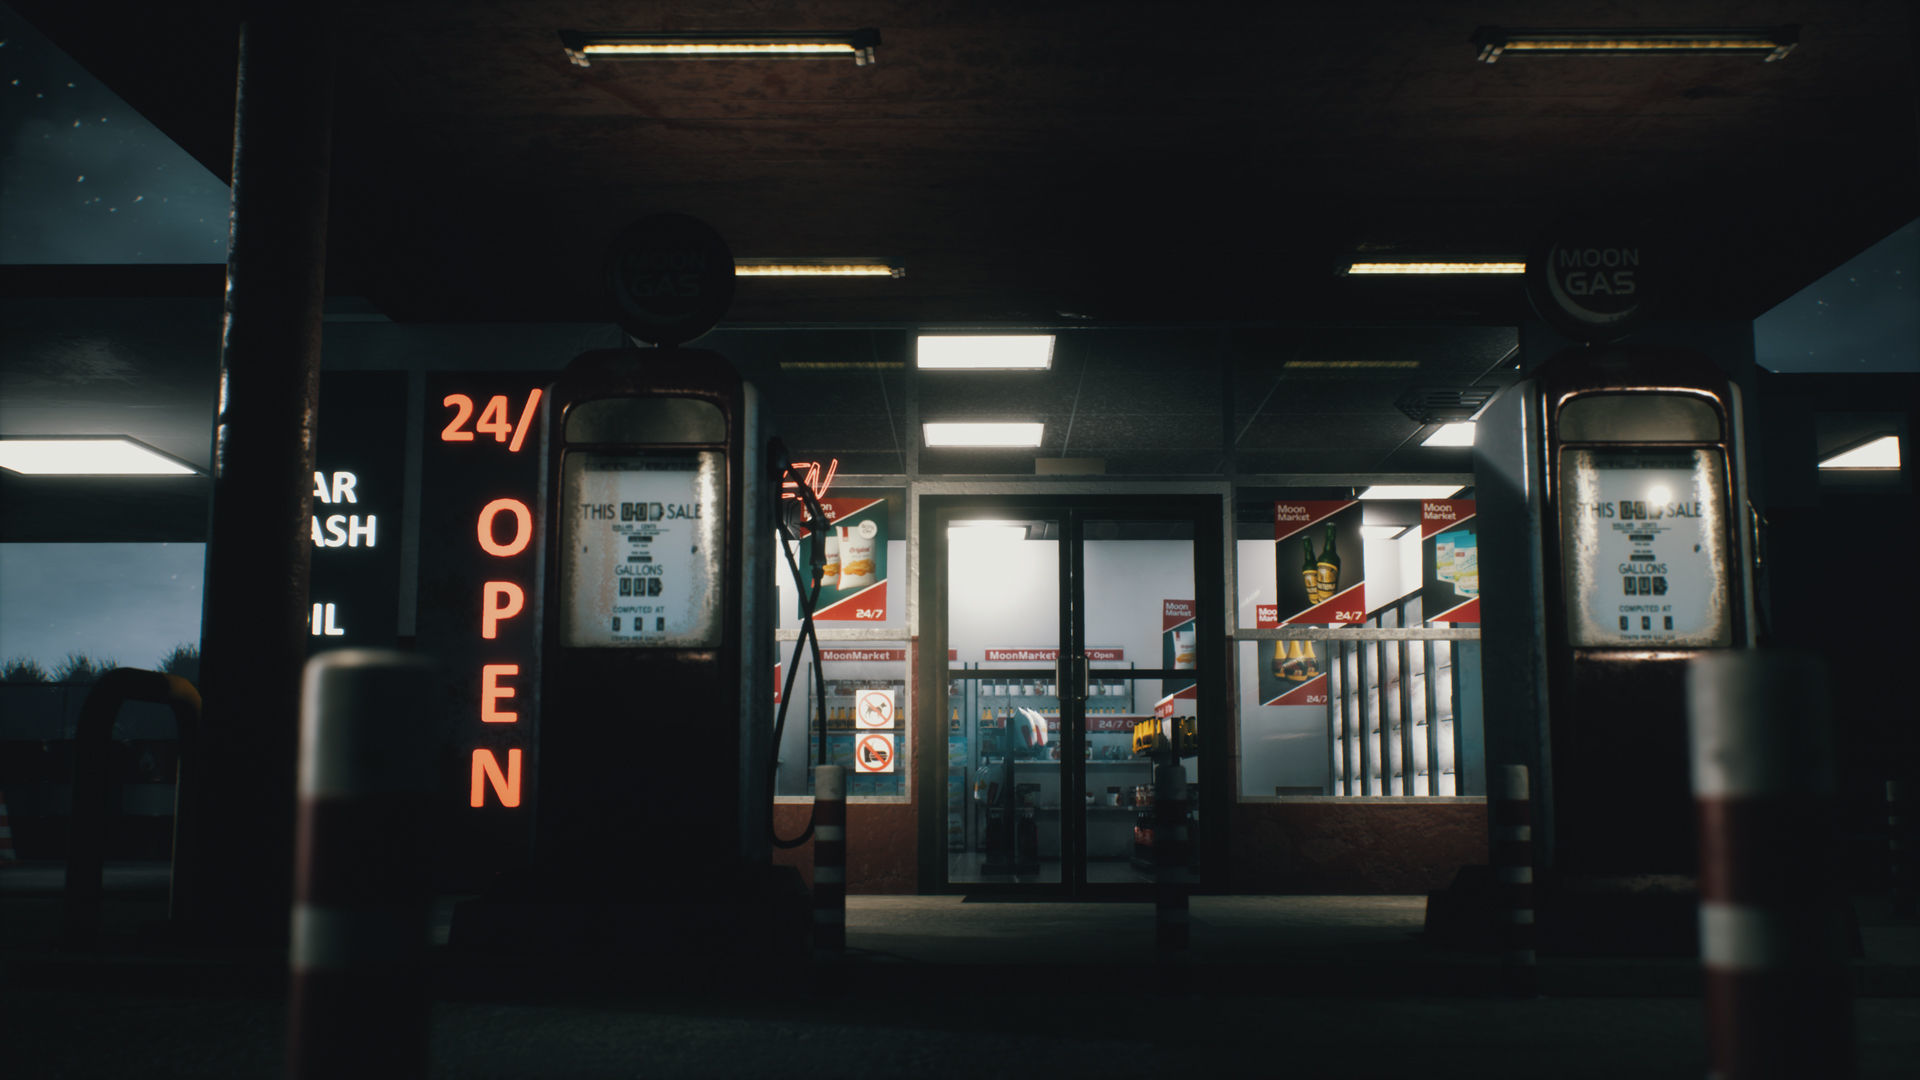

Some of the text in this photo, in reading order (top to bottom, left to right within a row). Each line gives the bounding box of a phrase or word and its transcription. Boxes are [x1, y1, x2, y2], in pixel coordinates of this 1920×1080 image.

[1560, 248, 1640, 268] MOON
[632, 273, 701, 297] GAS
[1565, 271, 1636, 296] GAS
[441, 388, 543, 452] 24/
[313, 471, 358, 503] AR
[581, 503, 616, 519] THIS
[666, 503, 703, 520] SALE
[1277, 504, 1306, 514] Moon
[1424, 503, 1452, 513] Moon
[1666, 502, 1703, 518] SALE
[1277, 513, 1310, 522] Market
[1424, 511, 1457, 521] Market
[311, 514, 377, 547] ASH
[615, 565, 663, 576] GALLONS
[1618, 563, 1668, 575] GALLONS
[612, 606, 665, 614] COMPUTED AT
[1166, 602, 1189, 610] Moon
[1619, 605, 1672, 613] COMPUTED AT
[856, 609, 884, 619] 24/7
[1166, 609, 1192, 617] Market
[1258, 607, 1277, 616] Moo
[1335, 611, 1363, 621] 24/7
[310, 602, 345, 636] IL
[470, 498, 534, 808] OPEN
[823, 651, 891, 661] MoonMarket
[989, 651, 1056, 660] MoonMarket
[1093, 652, 1115, 660] Open
